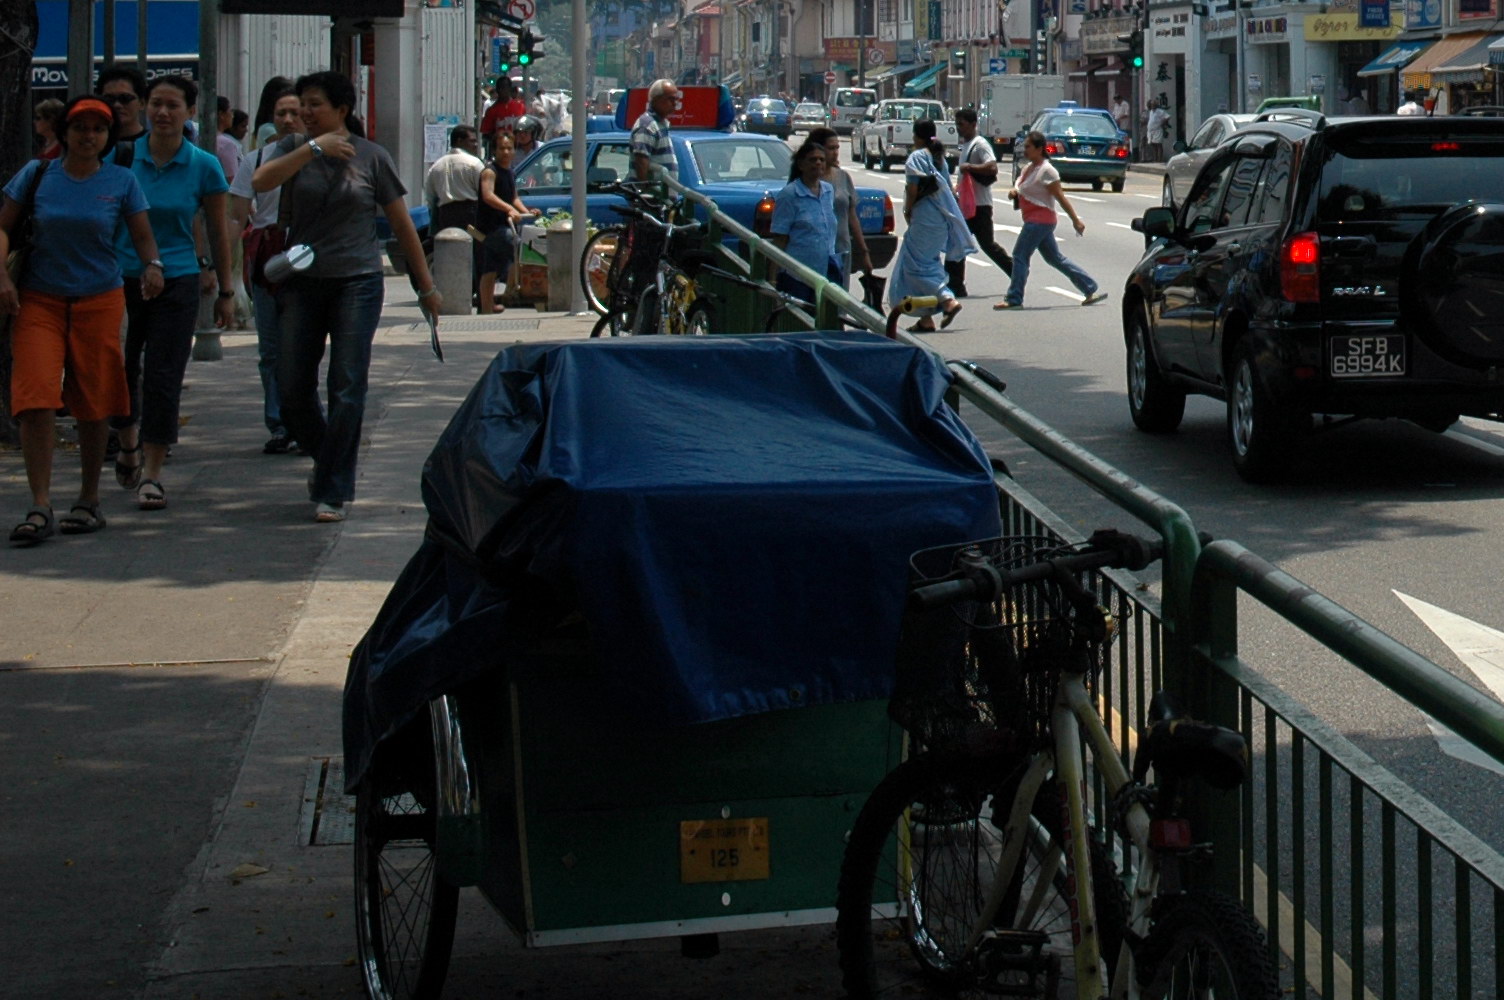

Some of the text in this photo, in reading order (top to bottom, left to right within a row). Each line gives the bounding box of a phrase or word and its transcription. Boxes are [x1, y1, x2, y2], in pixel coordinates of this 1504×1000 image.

[1348, 337, 1388, 355] SFB
[1333, 354, 1402, 374] 6994K
[710, 848, 740, 868] 125
